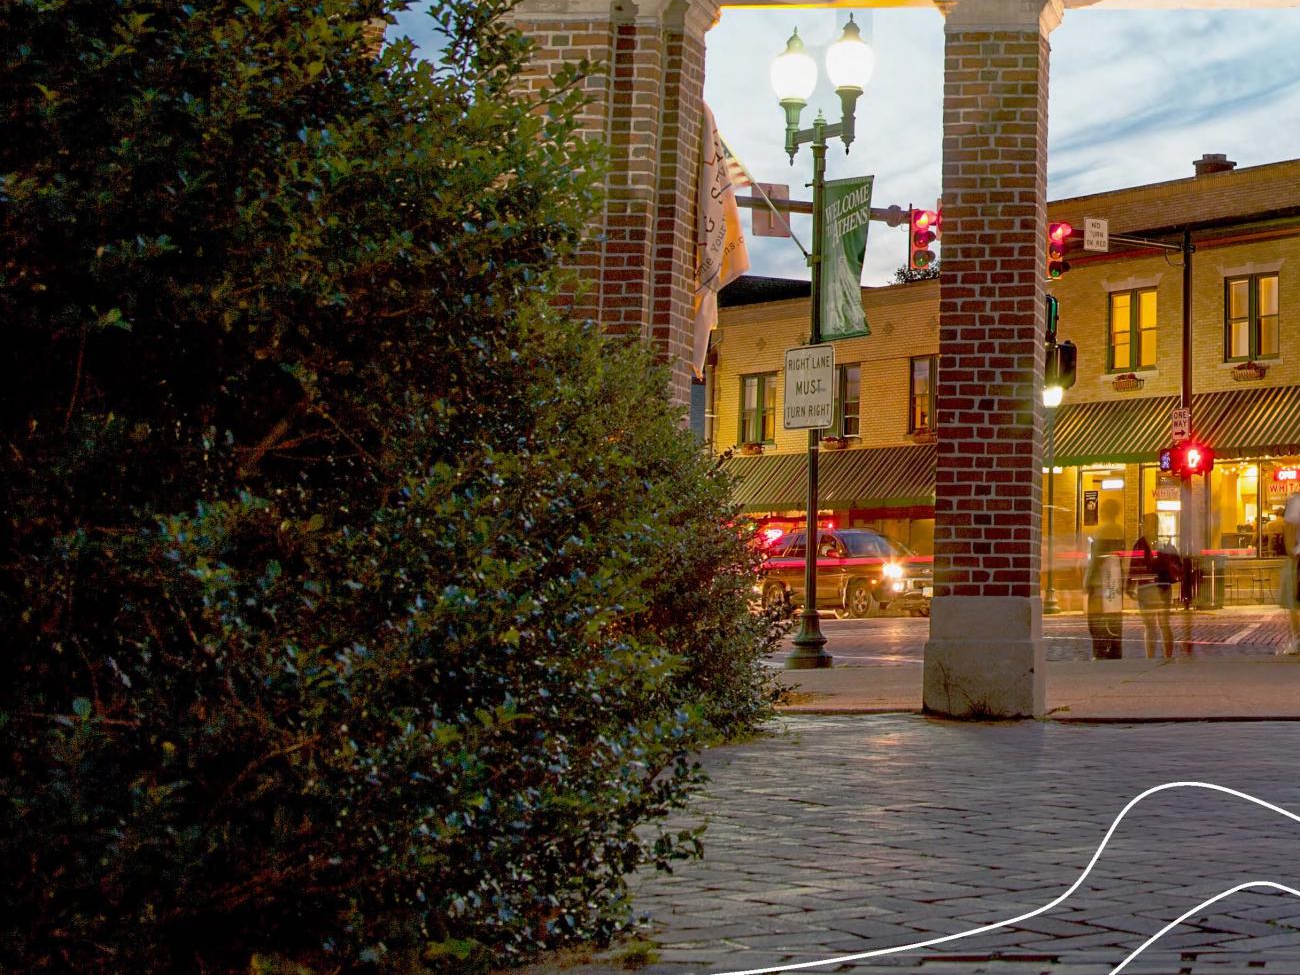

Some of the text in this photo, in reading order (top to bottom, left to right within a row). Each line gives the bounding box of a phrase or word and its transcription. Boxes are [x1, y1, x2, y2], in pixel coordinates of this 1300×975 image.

[825, 184, 870, 224] WELCOME
[832, 206, 868, 249] ATHENS
[1091, 221, 1101, 229] NO
[788, 355, 831, 371] RIGHT LANE
[795, 378, 823, 396] MUST
[786, 403, 831, 419] TURN RIGHT
[1173, 410, 1188, 420] ONE
[1173, 419, 1186, 428] WAY
